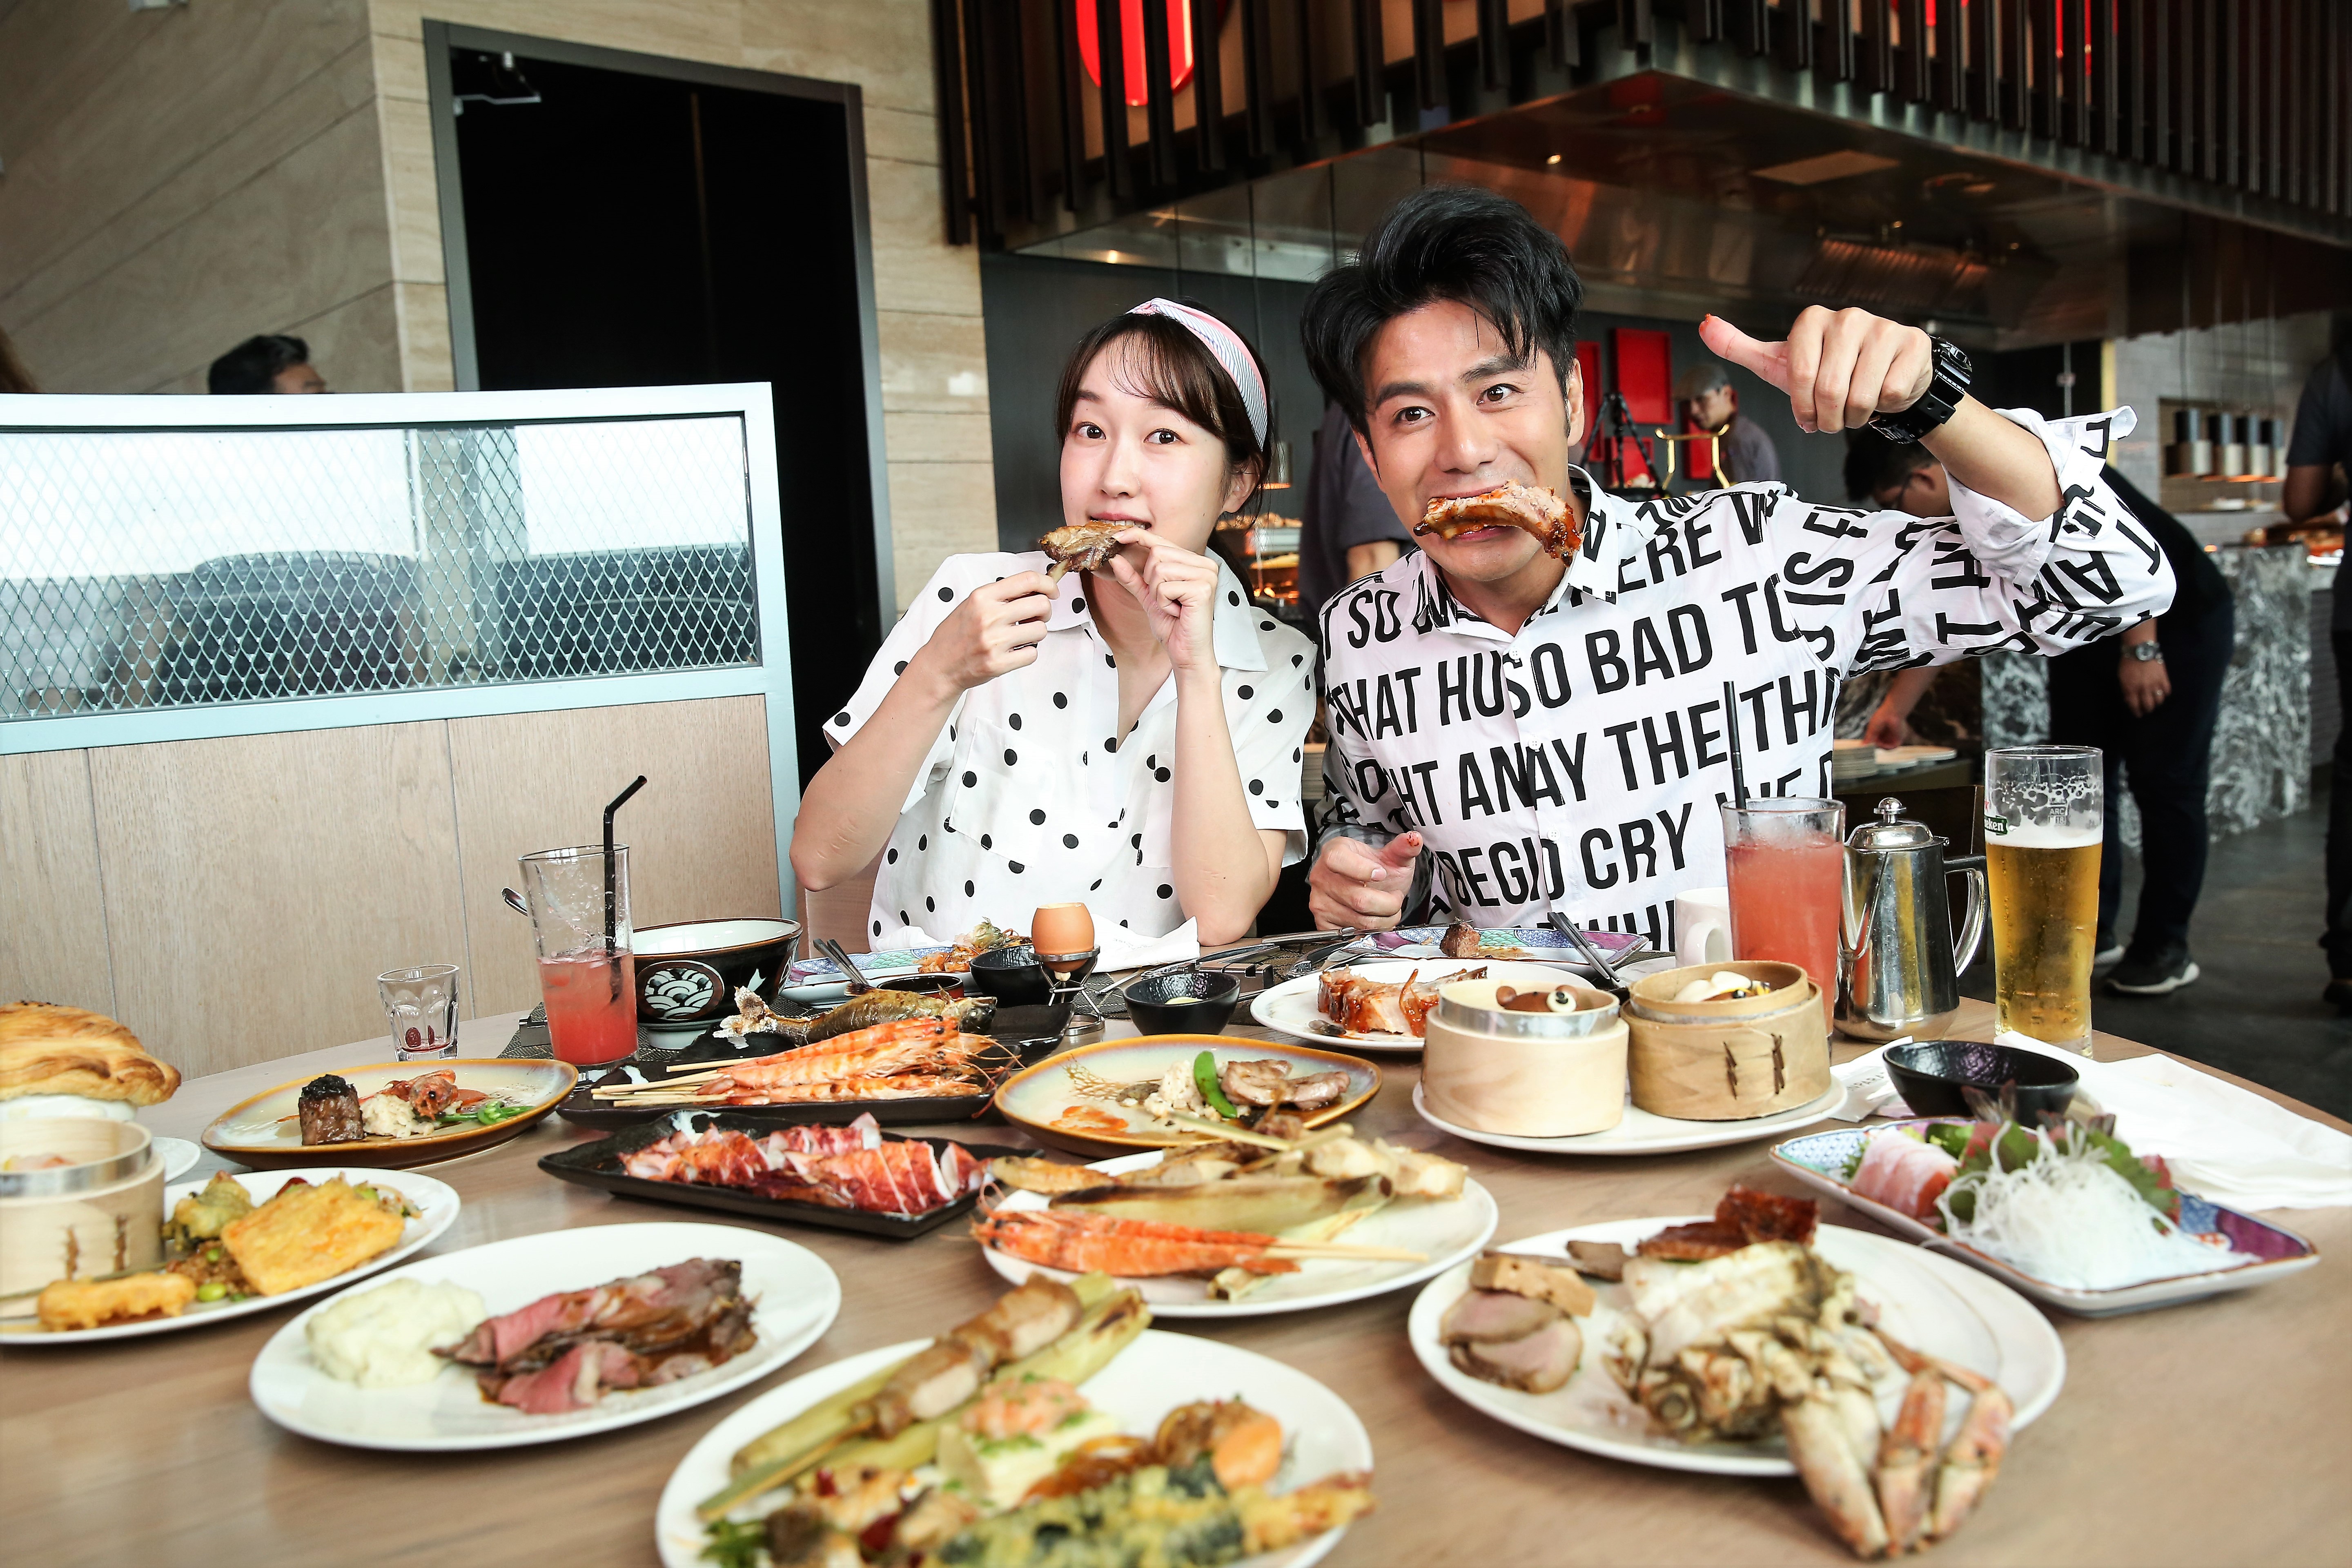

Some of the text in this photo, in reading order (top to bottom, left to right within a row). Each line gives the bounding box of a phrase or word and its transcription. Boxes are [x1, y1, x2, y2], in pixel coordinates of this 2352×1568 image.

[1348, 589, 1402, 648] SO
[1585, 604, 1712, 694] BAD
[1604, 700, 1727, 791] THE
[1580, 802, 1692, 889] CRY
